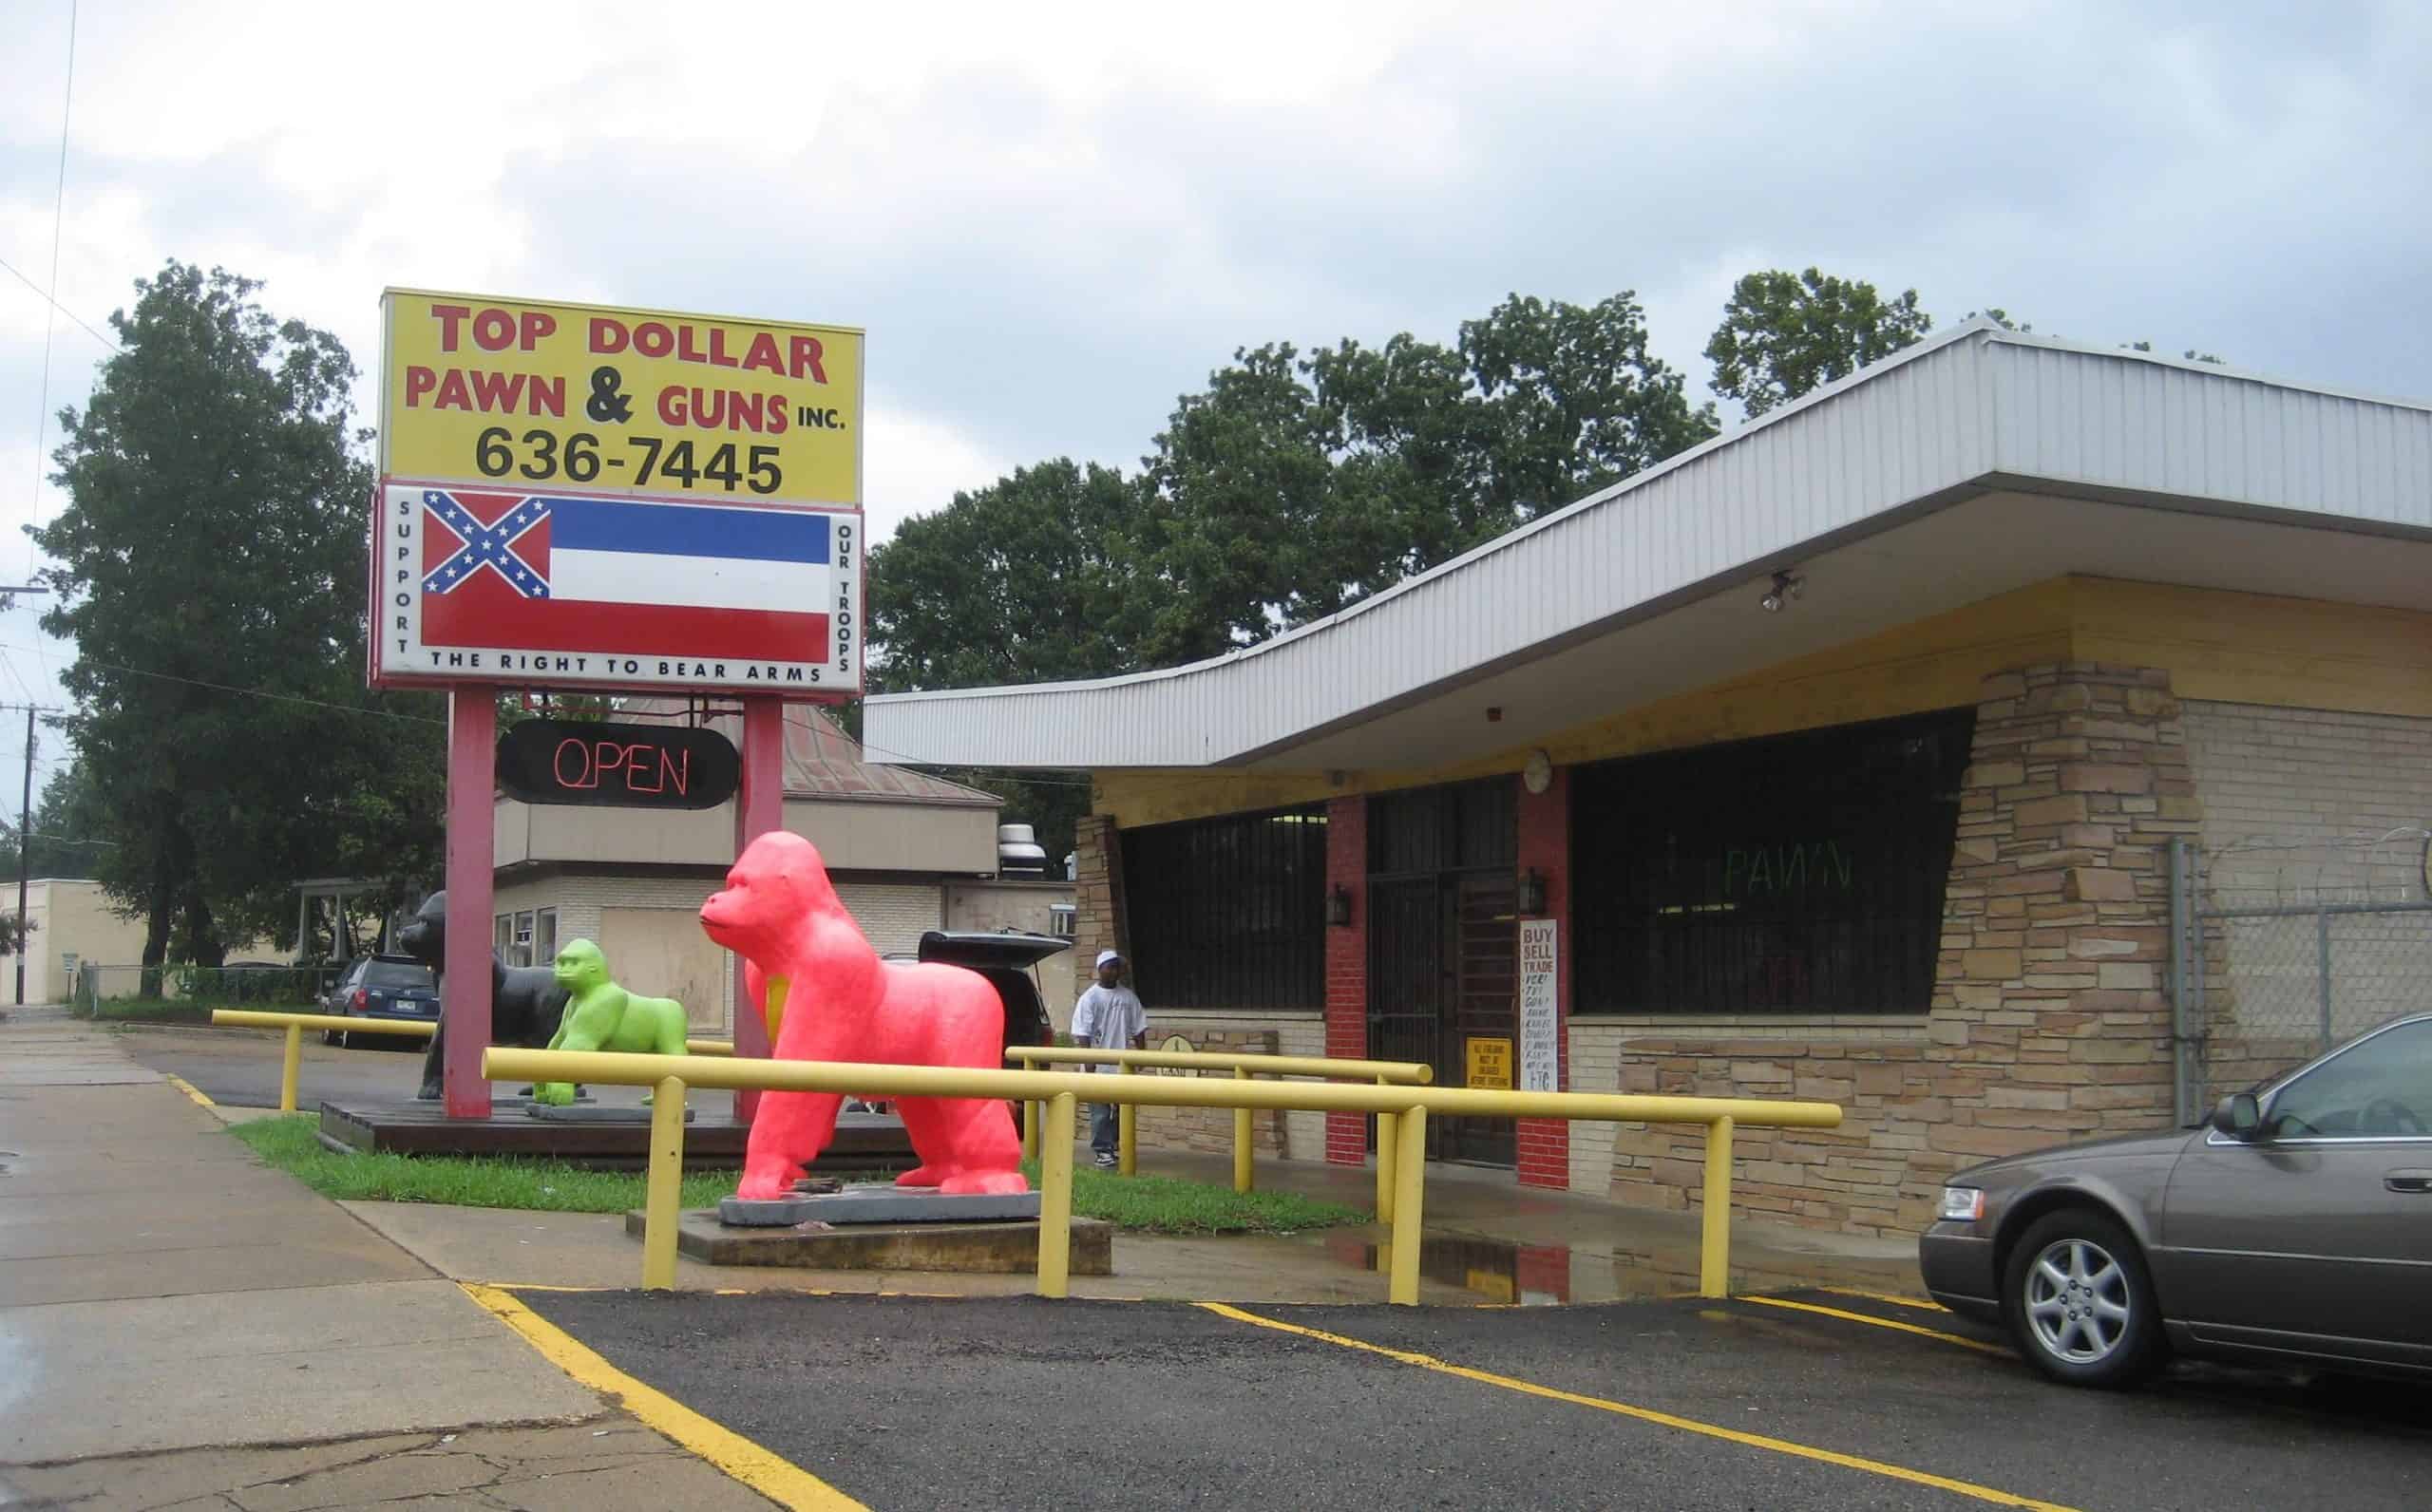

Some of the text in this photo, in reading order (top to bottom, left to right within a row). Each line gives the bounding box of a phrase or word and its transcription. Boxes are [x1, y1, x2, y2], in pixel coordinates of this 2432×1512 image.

[431, 304, 827, 384] TOP DOLLAR
[406, 366, 846, 434] PAWN & GUNS INC.
[477, 426, 782, 494] 636-7445
[394, 501, 411, 655] SUPPORT
[837, 525, 851, 672] OUR TROOPS
[432, 652, 821, 682] THE RIGHT TO BEAR ARMS
[554, 738, 689, 797] OPEN
[1523, 929, 1553, 944] BUY
[1524, 945, 1551, 959] SELL
[1524, 961, 1553, 973] TRADE
